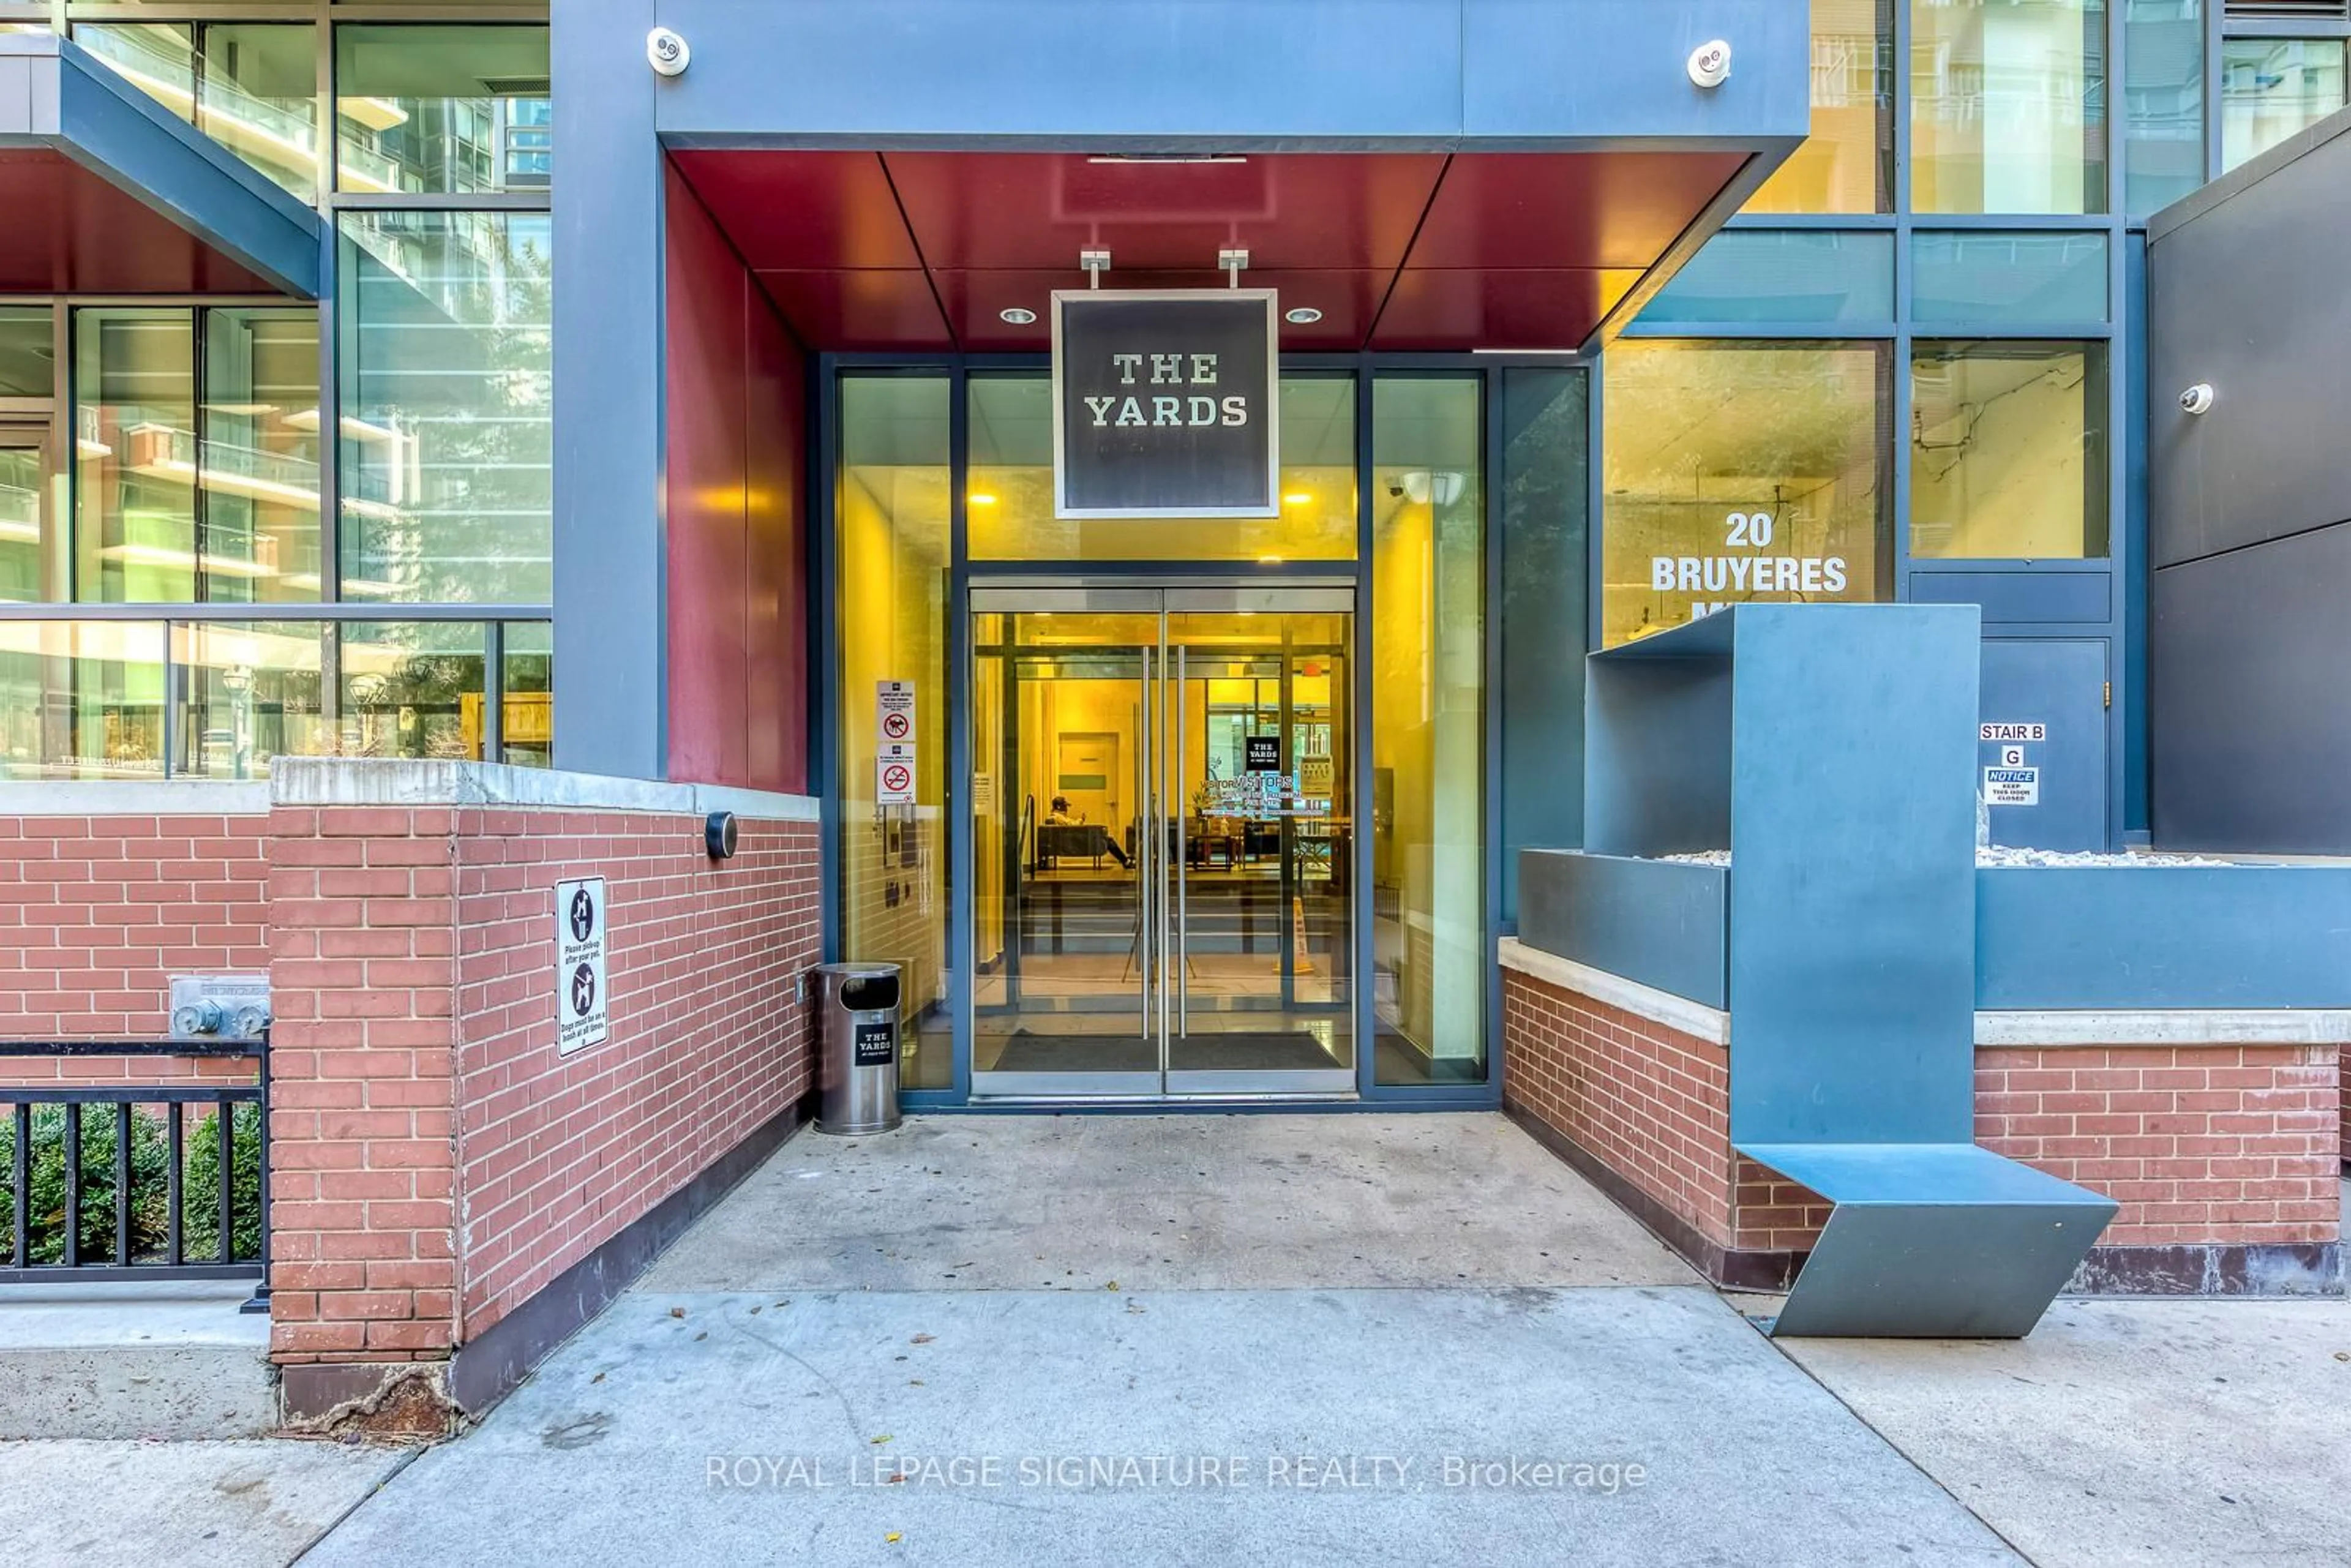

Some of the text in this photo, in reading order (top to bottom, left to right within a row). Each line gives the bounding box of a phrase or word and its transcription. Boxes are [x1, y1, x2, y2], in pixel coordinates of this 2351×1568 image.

[1113, 354, 1217, 384] THE
[1084, 396, 1248, 426] YARDS
[1725, 512, 1772, 547] 20
[1652, 557, 1847, 592] BRUYERES
[1982, 726, 2044, 739] STAIR B
[2006, 750, 2020, 765] G
[1990, 771, 2033, 781] NOTICE
[865, 1033, 887, 1041] THE
[859, 1041, 891, 1050] YARDS
